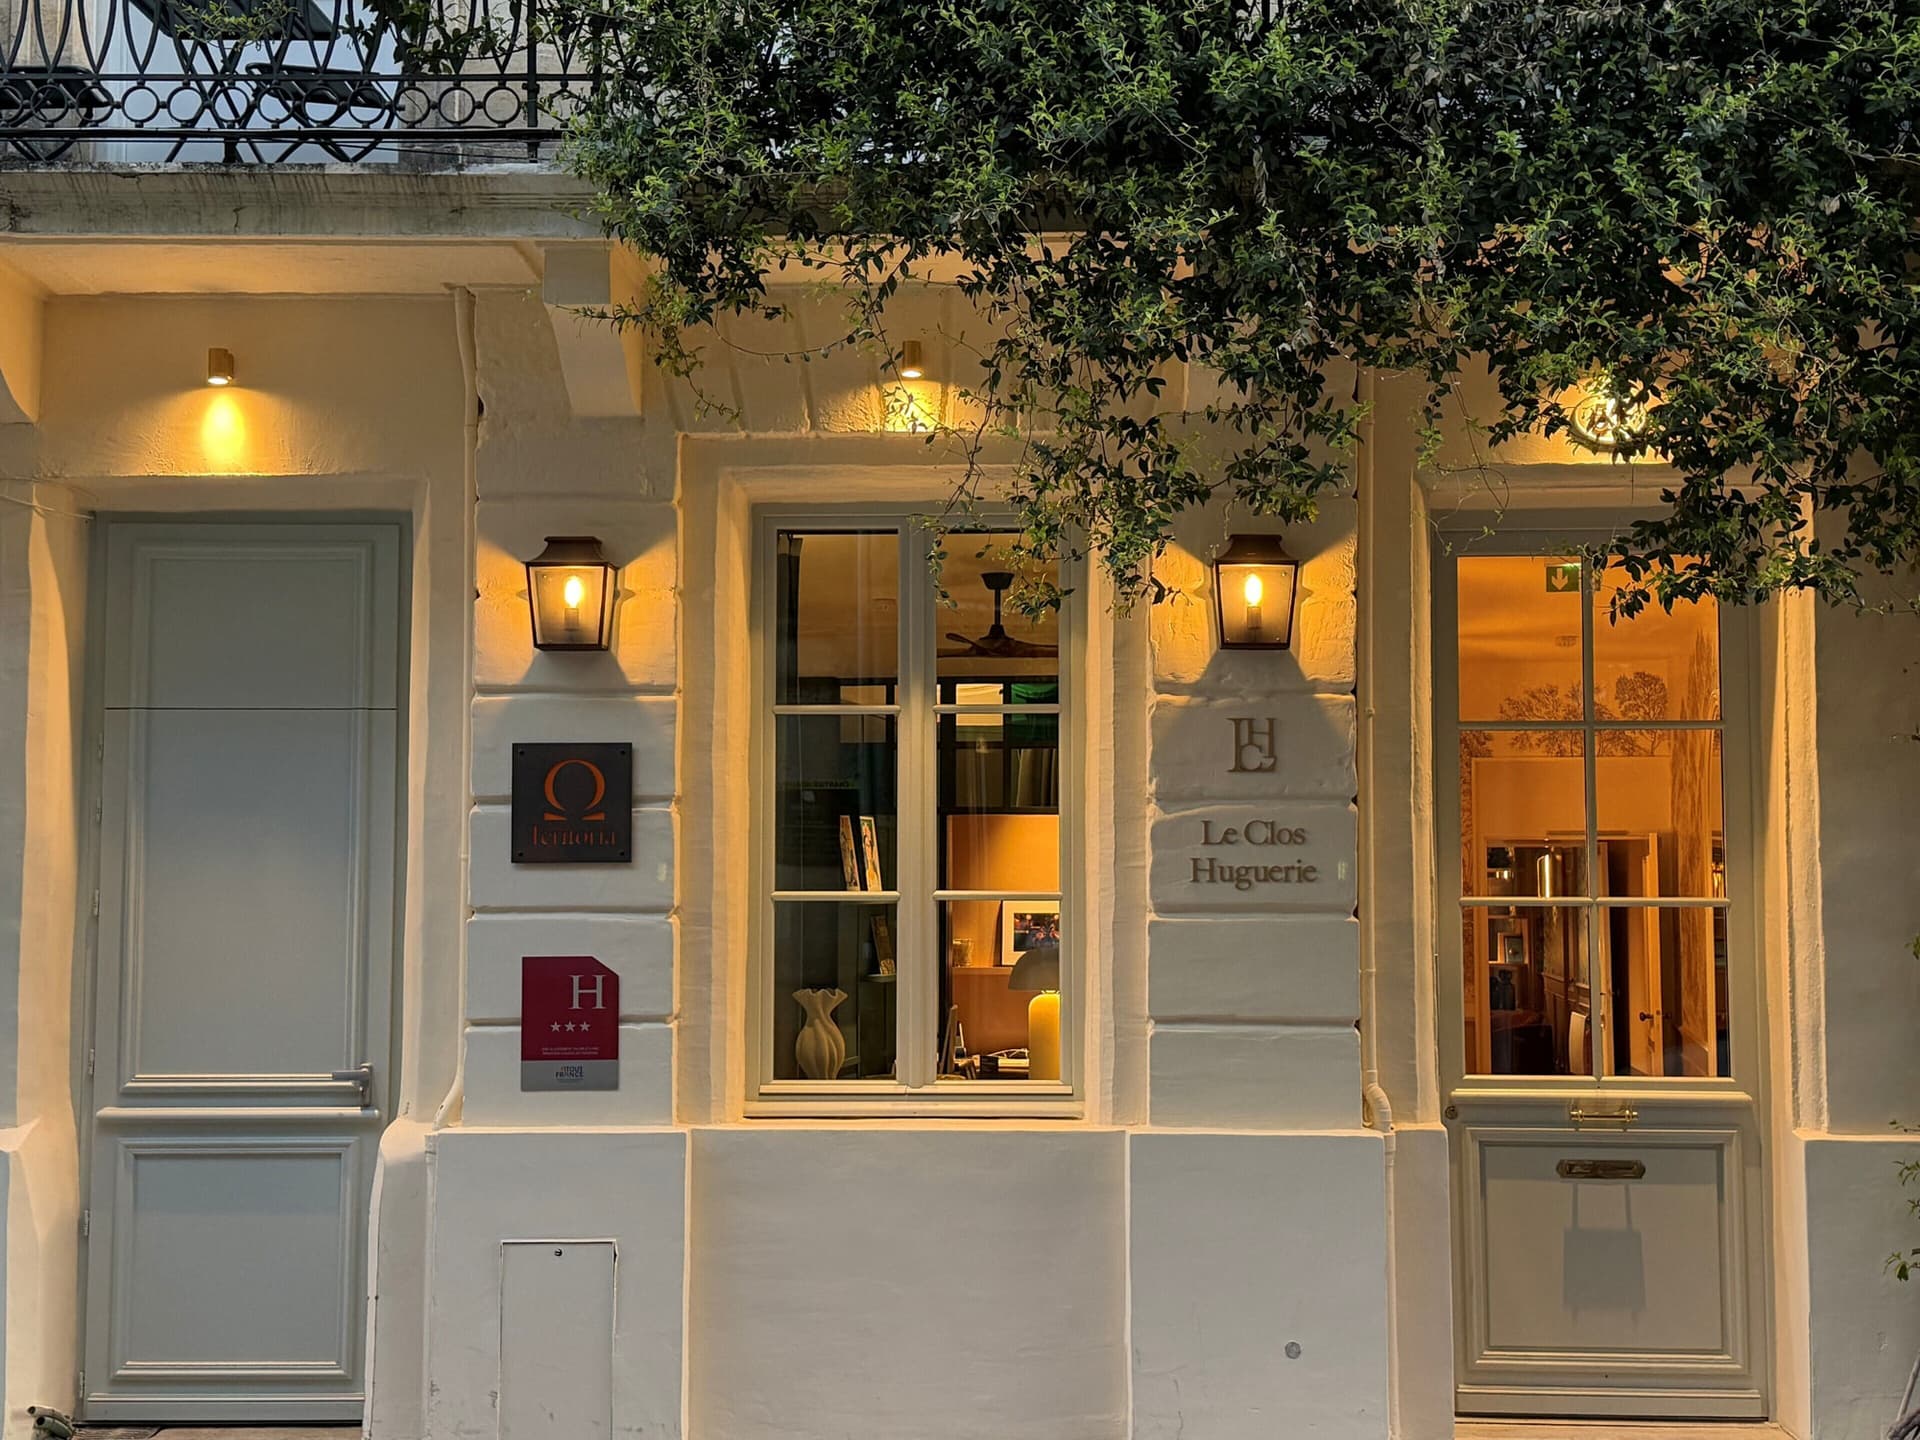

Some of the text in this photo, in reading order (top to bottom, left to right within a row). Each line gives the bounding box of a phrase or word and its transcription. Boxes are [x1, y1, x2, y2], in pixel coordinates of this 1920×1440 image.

[1201, 819, 1306, 846] Le Clos
[1190, 858, 1318, 891] Huguerie
[568, 974, 607, 1010] H
